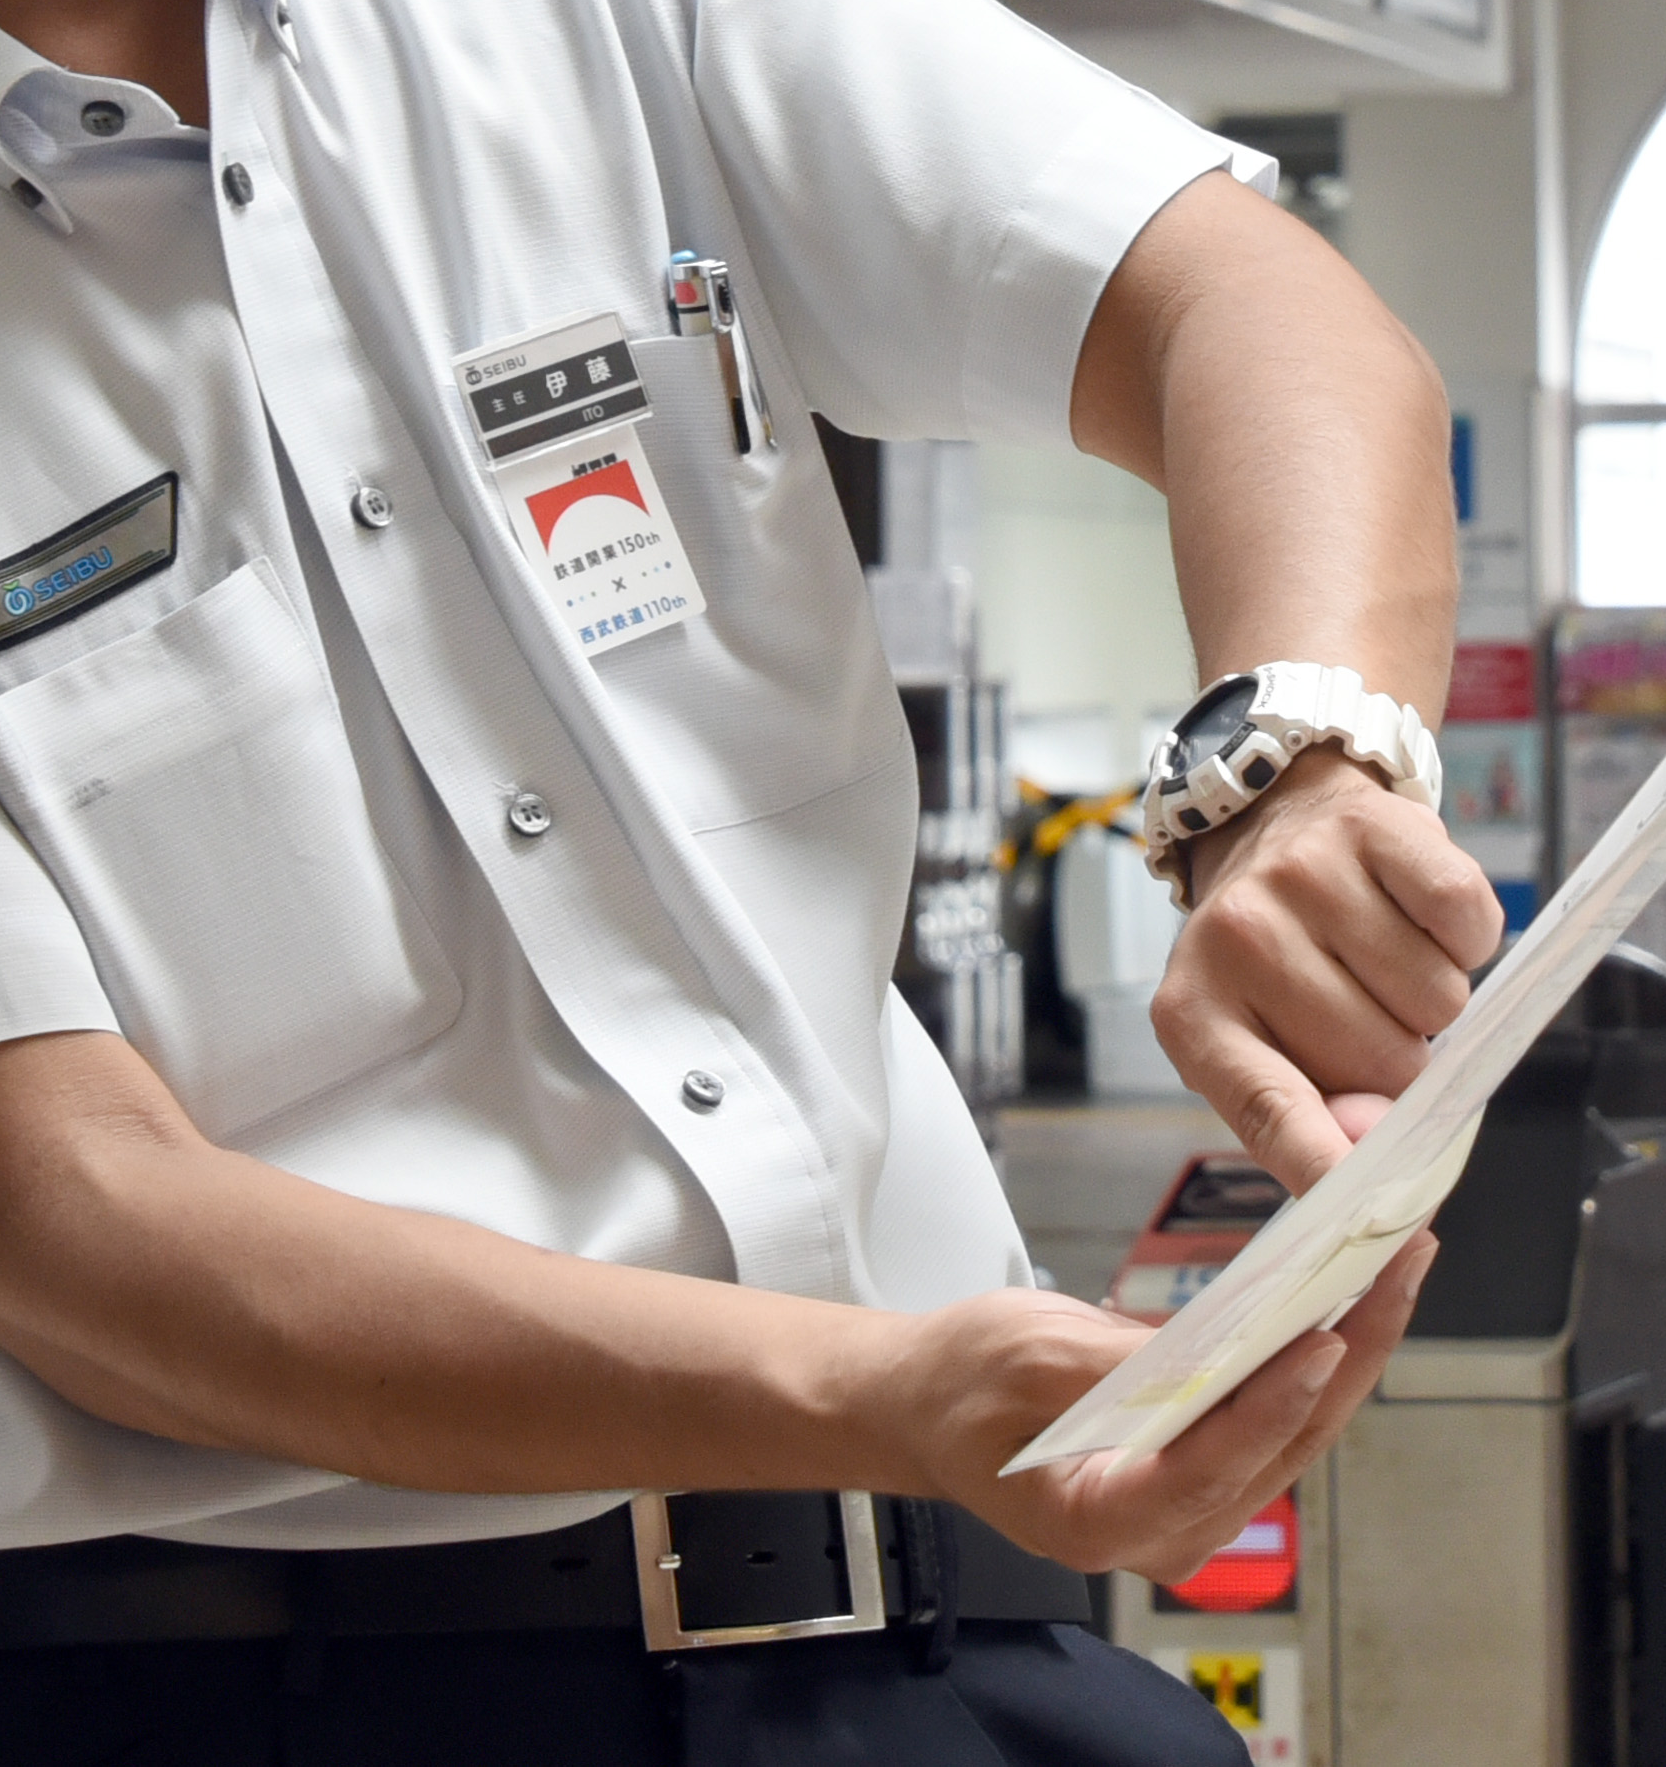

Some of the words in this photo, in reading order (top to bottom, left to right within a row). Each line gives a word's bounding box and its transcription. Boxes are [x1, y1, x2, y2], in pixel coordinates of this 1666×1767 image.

[483, 355, 527, 379] SEIBU
[545, 356, 613, 399] 伊藤
[582, 405, 605, 422] ITO
[33, 546, 114, 601] SEIBU
